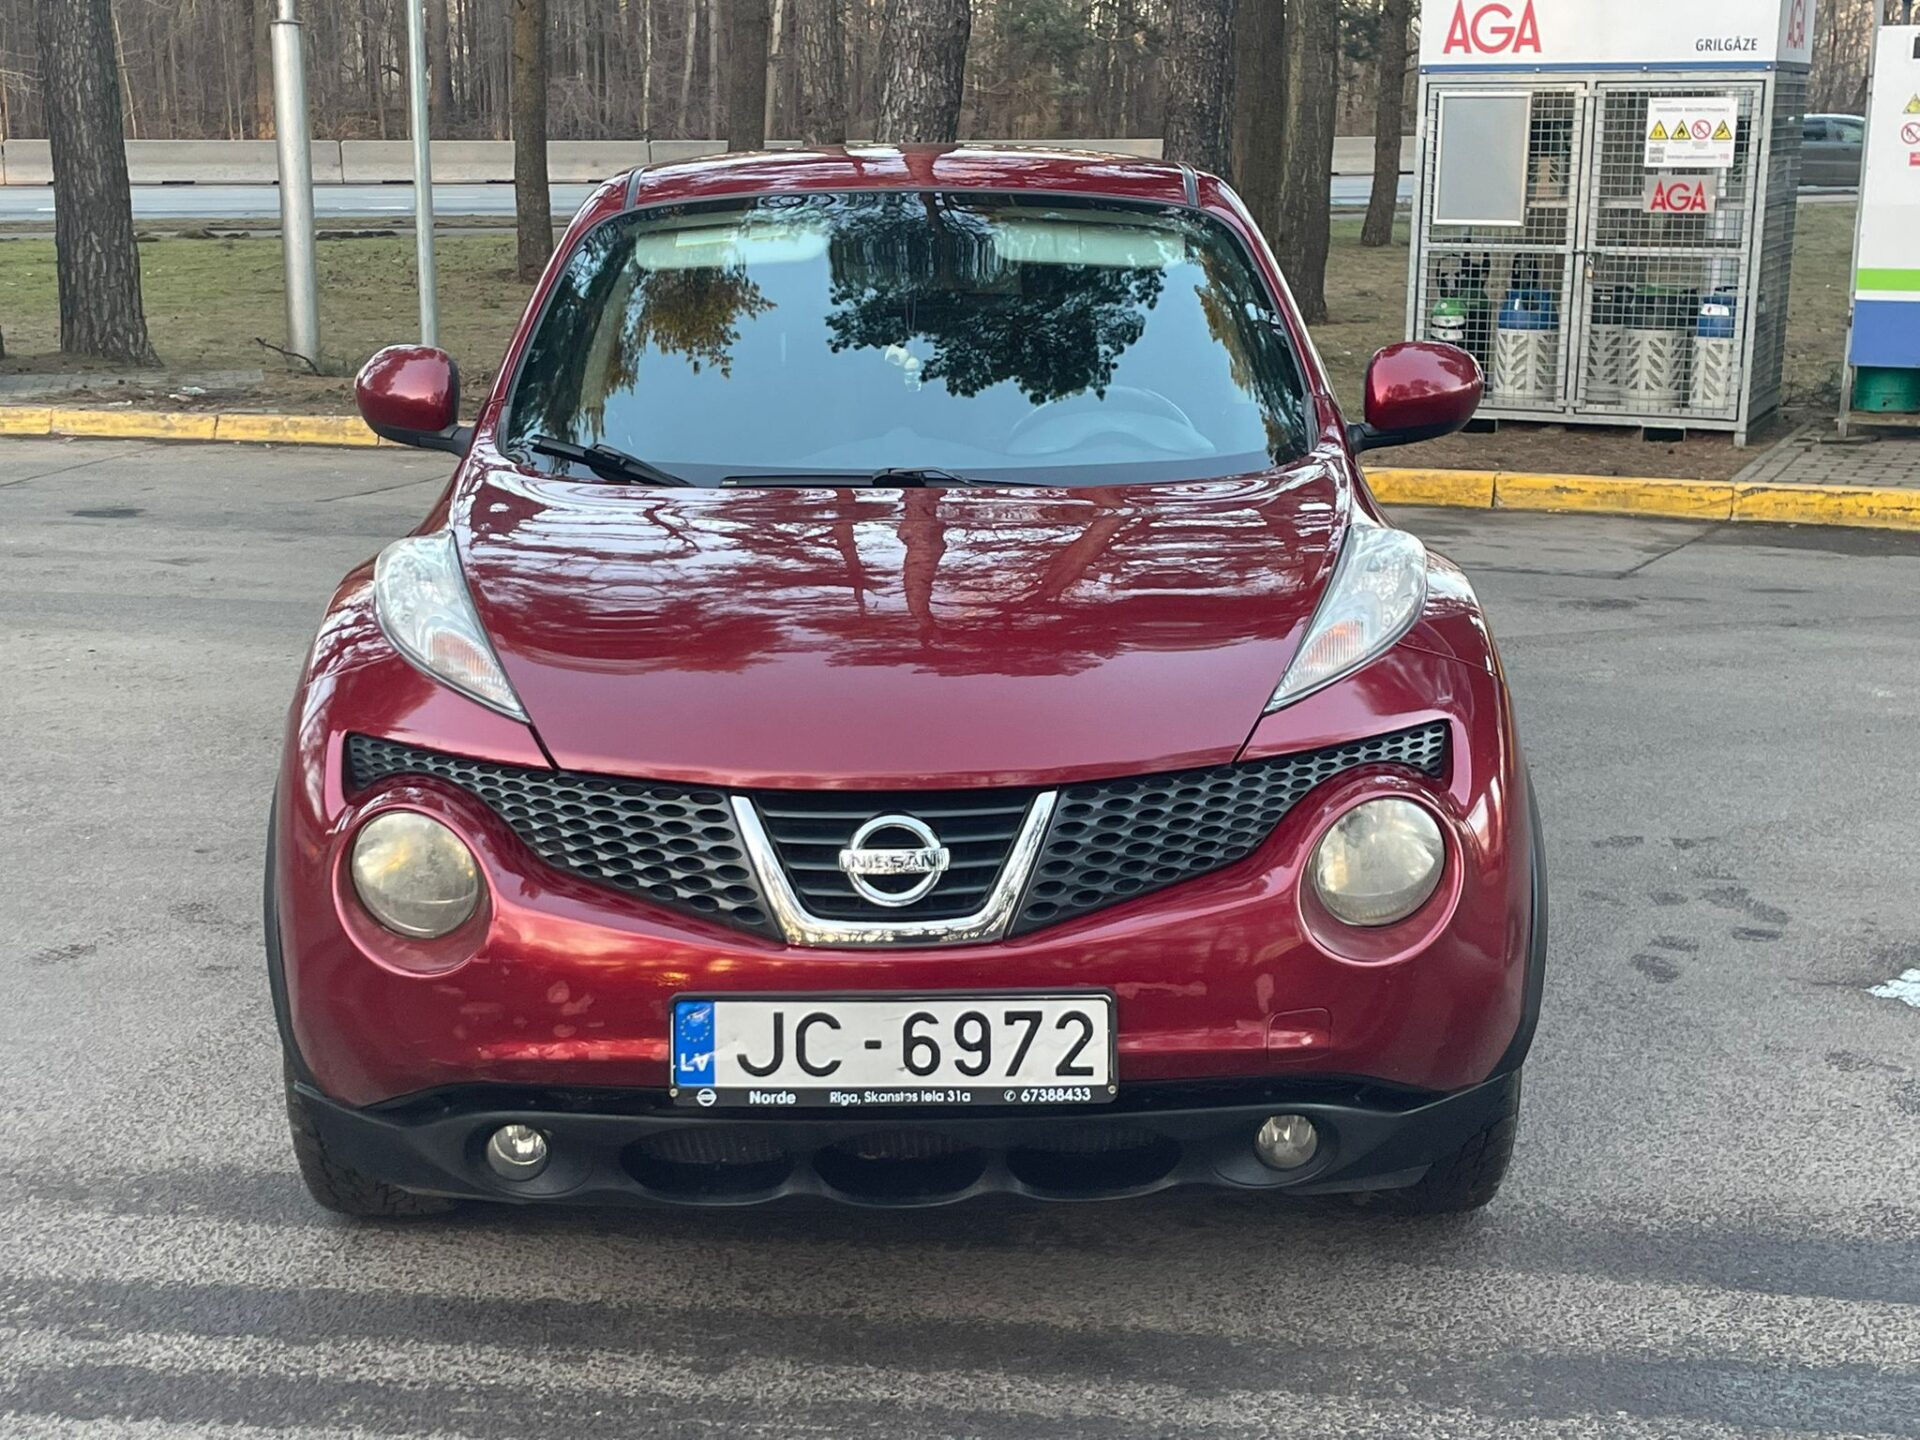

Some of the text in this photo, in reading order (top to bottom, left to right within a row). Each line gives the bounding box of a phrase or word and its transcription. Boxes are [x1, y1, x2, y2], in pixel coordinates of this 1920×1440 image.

[1443, 0, 1542, 54] AGA
[1650, 179, 1707, 211] AGA
[851, 852, 937, 869] NISSAN
[680, 1053, 710, 1072] LV
[749, 1090, 797, 1105] Norde
[947, 1090, 971, 1102] 31a
[1020, 1087, 1091, 1102] 67388433
